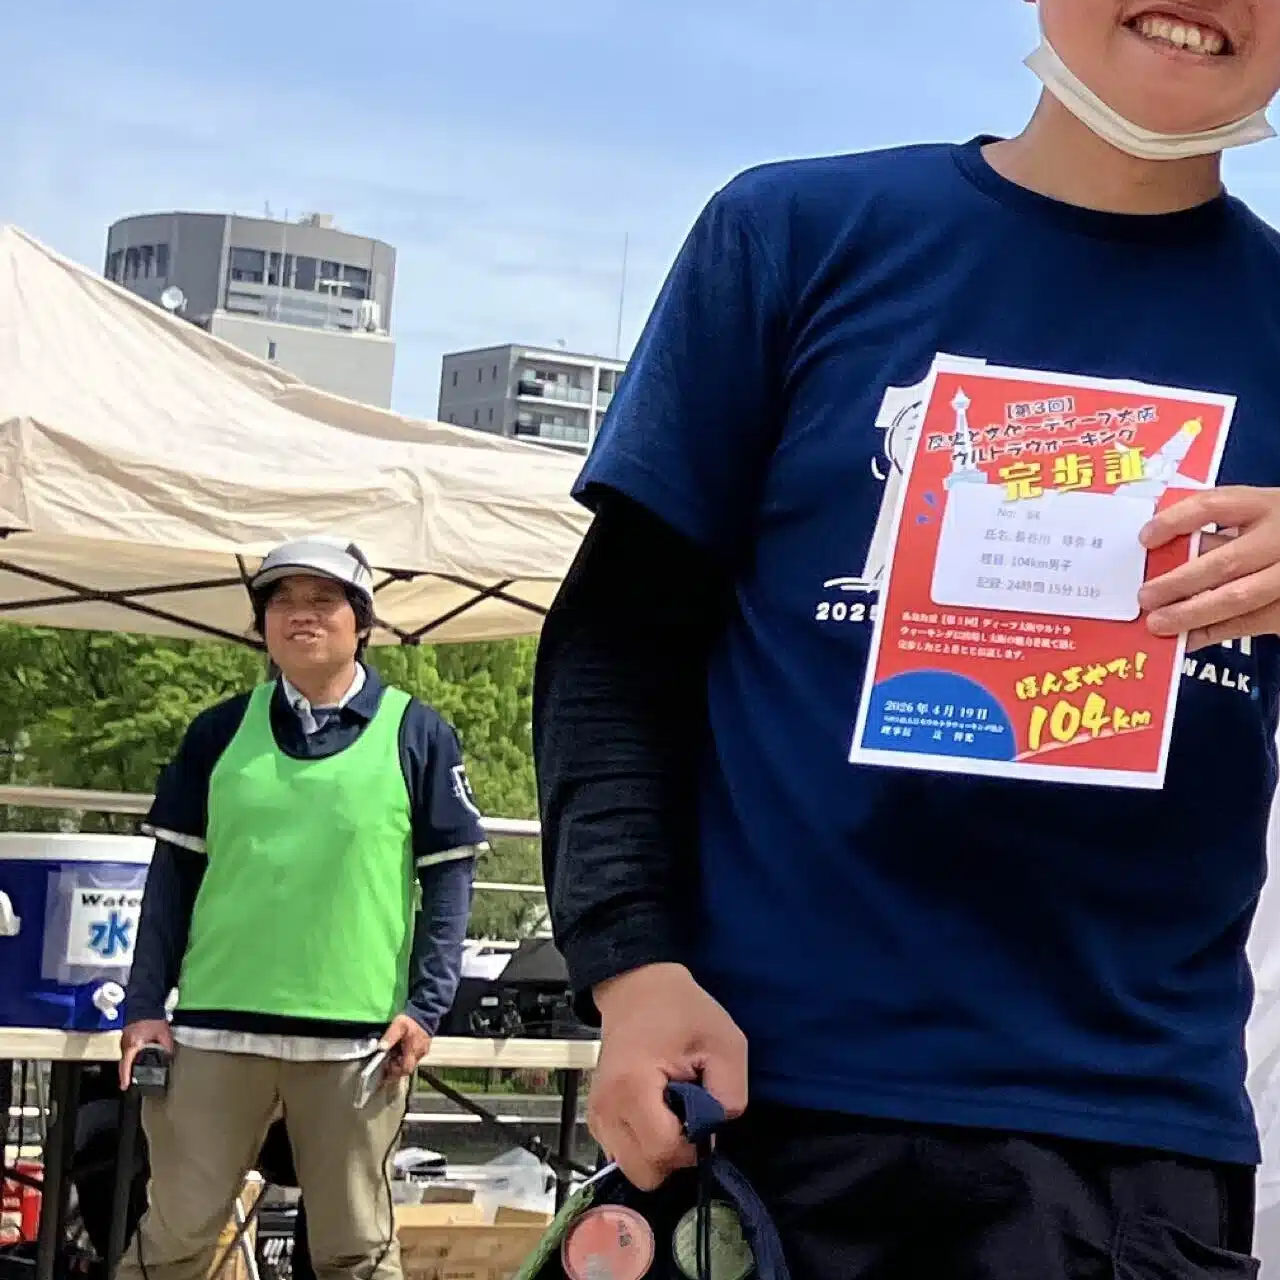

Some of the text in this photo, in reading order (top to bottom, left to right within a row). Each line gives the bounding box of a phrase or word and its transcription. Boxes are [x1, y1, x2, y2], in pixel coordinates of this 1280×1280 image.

[999, 446, 1146, 502] 完歩証
[82, 893, 142, 908] Wate
[90, 910, 131, 955] 水
